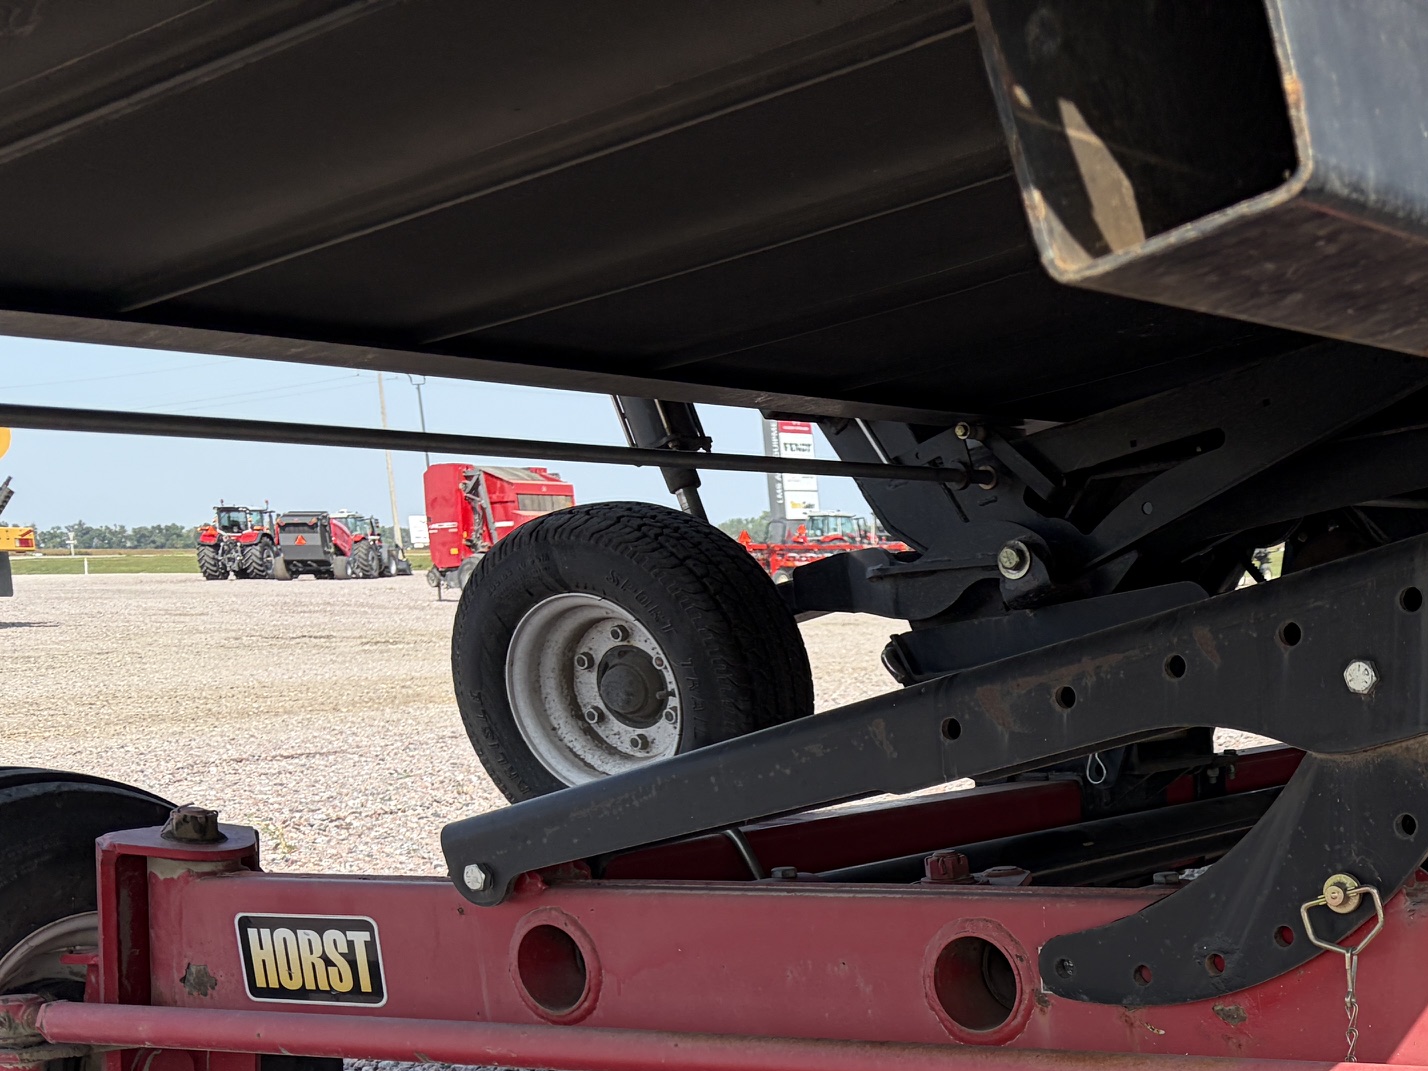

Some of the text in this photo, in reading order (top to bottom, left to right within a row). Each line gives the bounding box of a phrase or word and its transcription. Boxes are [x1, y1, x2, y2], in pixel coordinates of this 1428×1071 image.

[775, 482, 784, 504] LMS
[469, 689, 531, 795] ARLISLE
[247, 927, 373, 993] HORST
